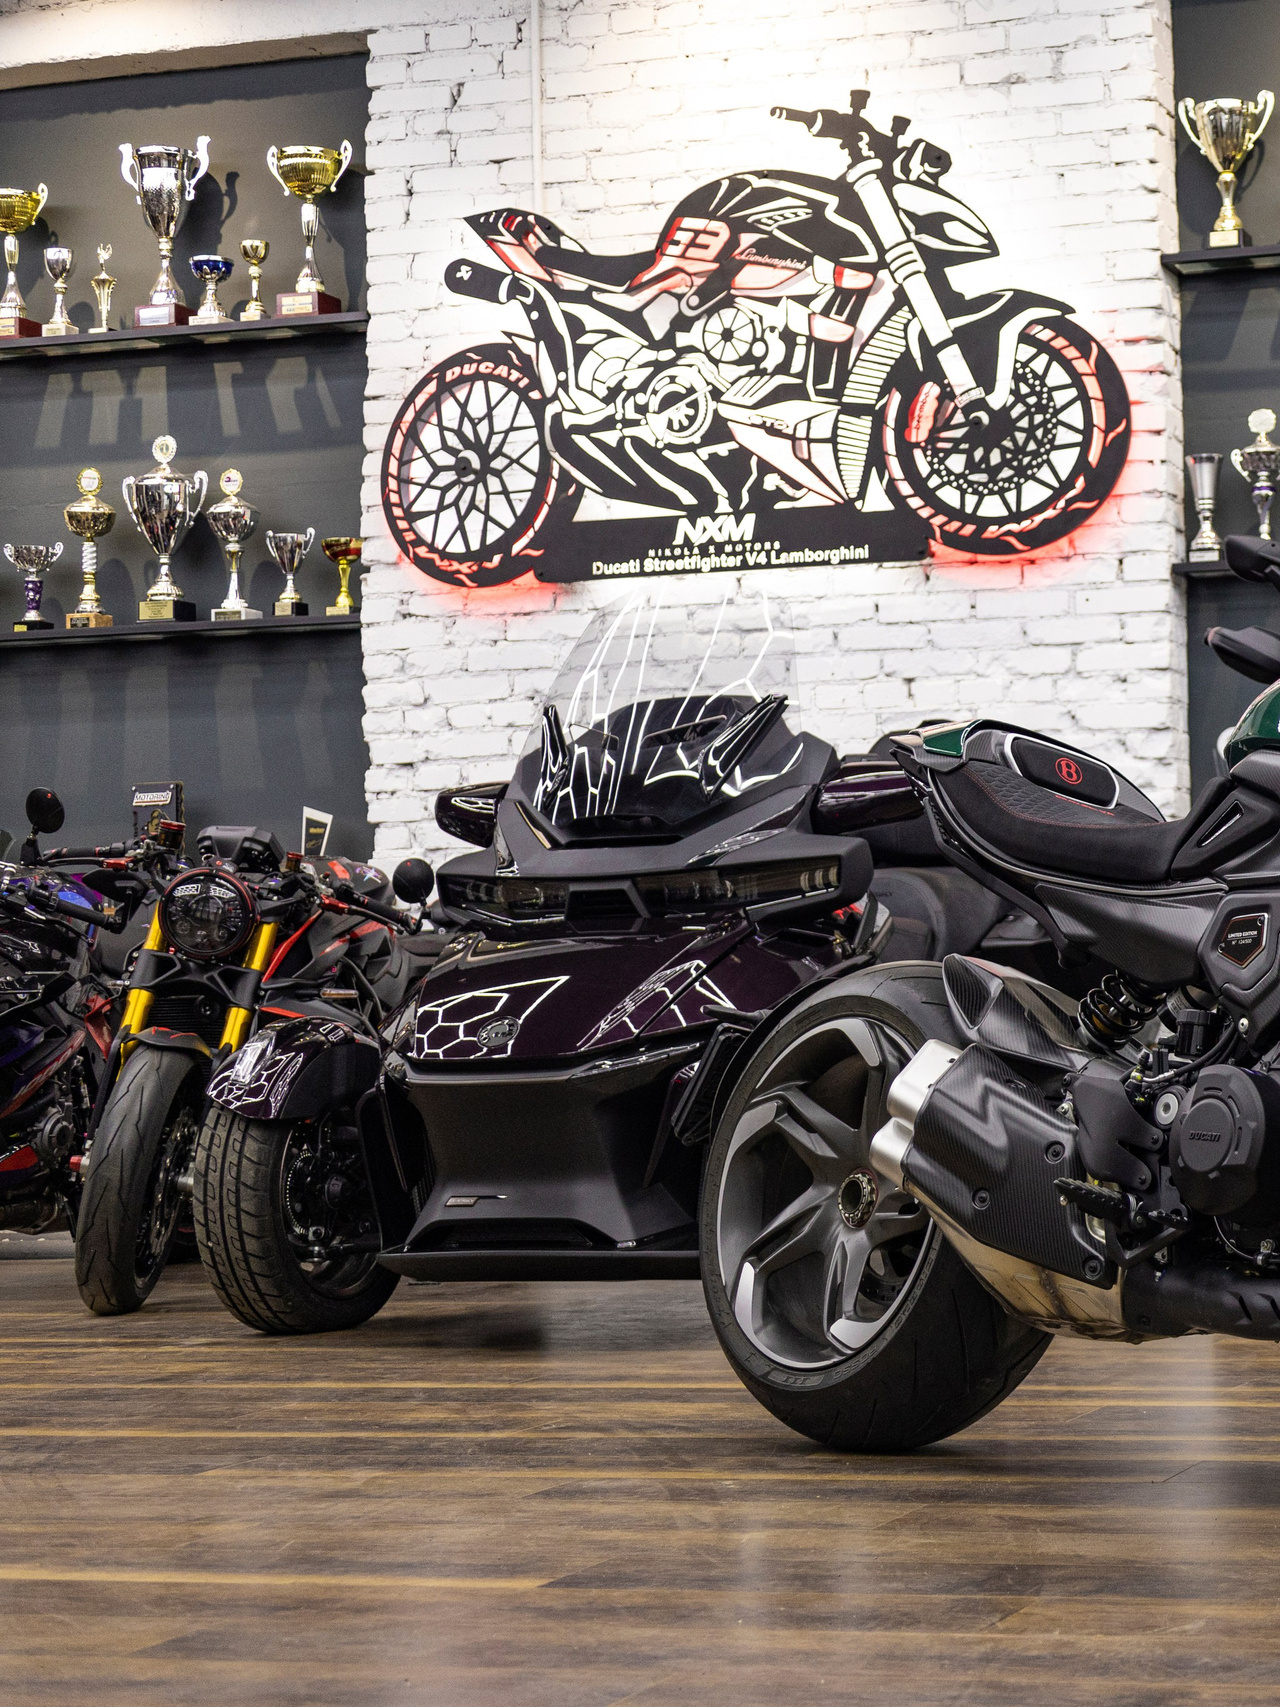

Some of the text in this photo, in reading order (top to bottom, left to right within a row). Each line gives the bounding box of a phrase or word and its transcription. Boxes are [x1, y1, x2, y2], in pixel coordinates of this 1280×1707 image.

[735, 248, 807, 270] Lamborghini
[445, 361, 530, 388] DUCATI
[913, 391, 930, 430] brembo
[672, 513, 756, 546] NXM
[592, 544, 870, 576] Ducati Streetfighter V4 Lamborghini
[648, 540, 781, 557] NIKOLA X MOTORS
[134, 791, 171, 802] MOTORING
[1189, 1130, 1221, 1143] DUCATI
